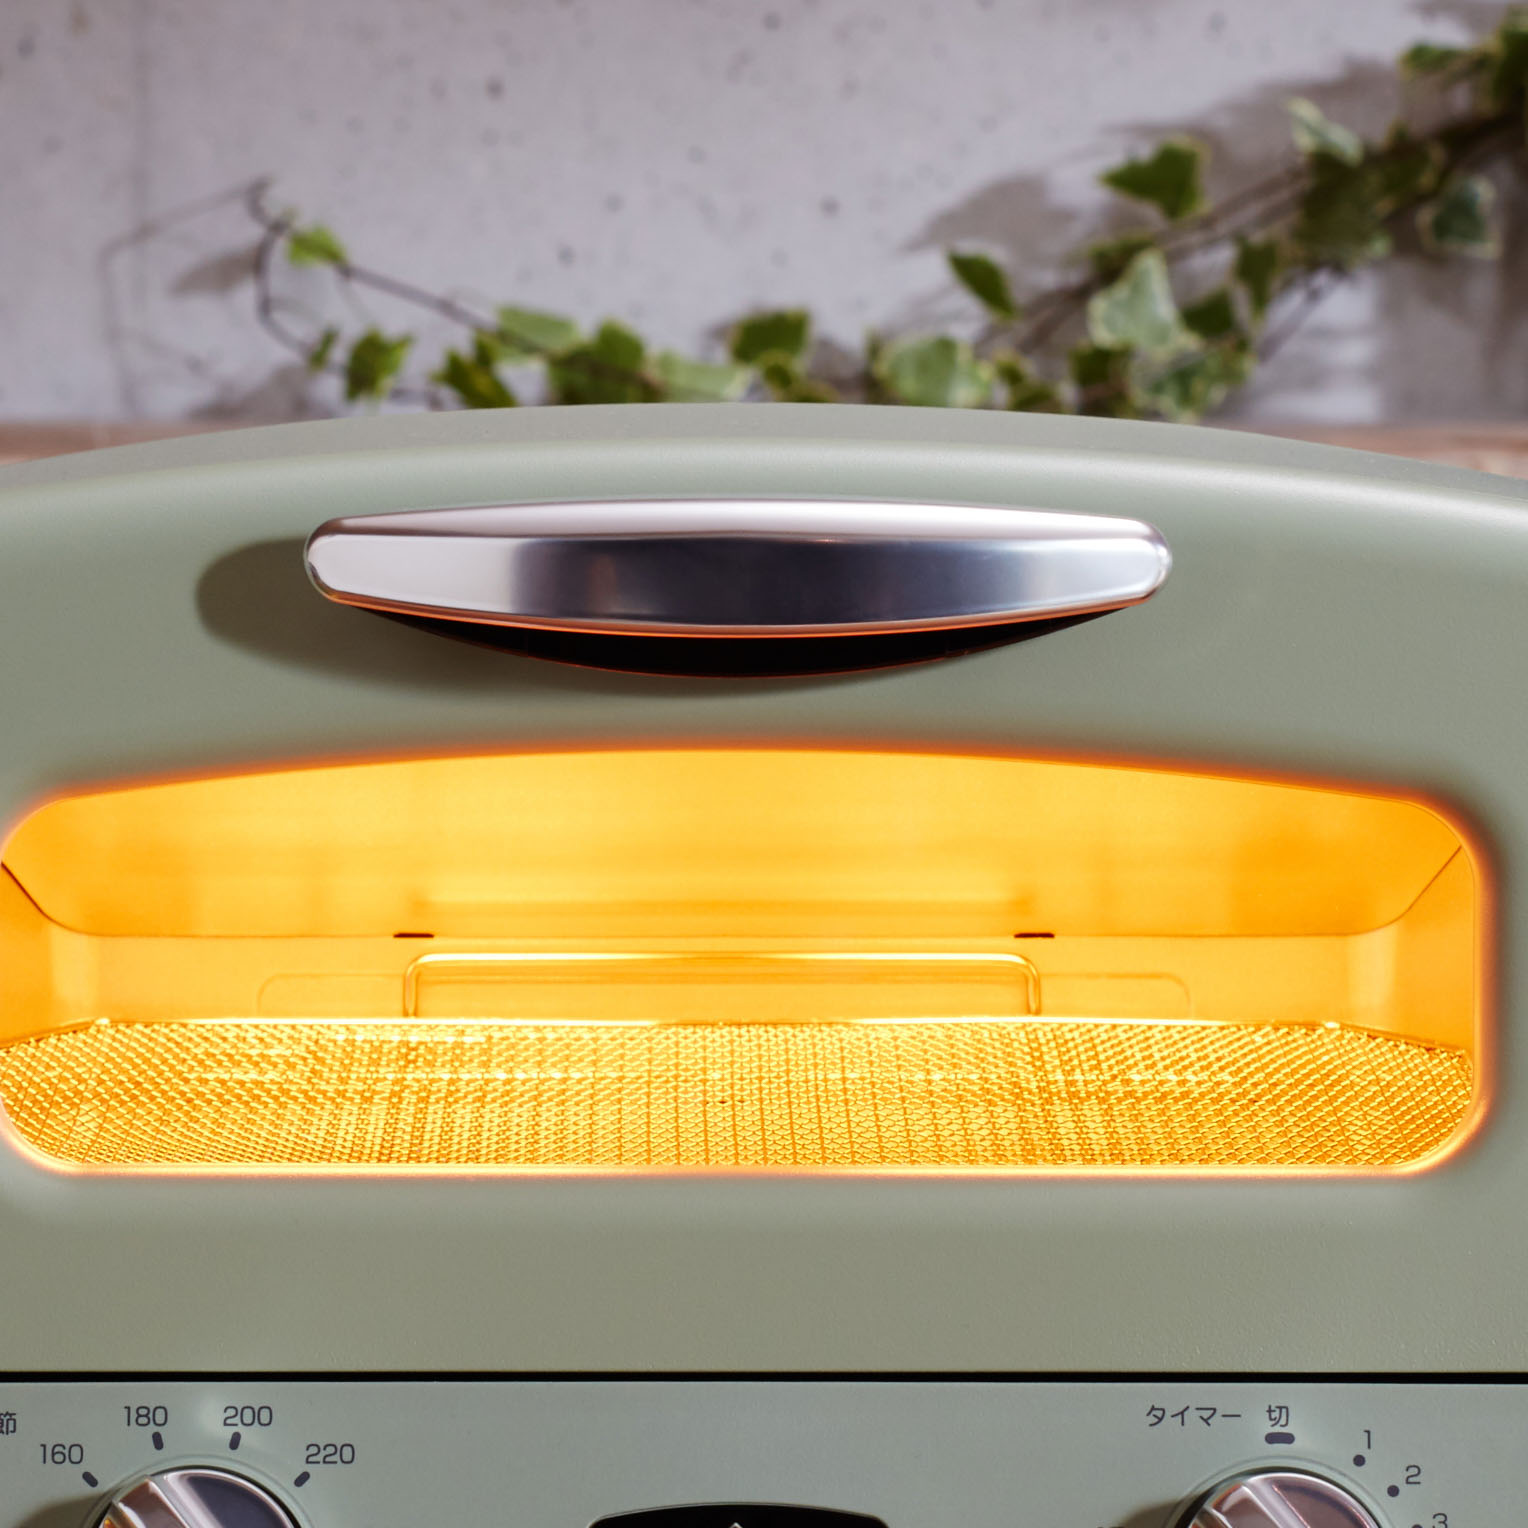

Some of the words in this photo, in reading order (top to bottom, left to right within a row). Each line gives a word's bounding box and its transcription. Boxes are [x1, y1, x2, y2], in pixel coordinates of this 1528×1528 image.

[123, 1405, 169, 1428] 180
[223, 1405, 273, 1427] 200
[1145, 1404, 1242, 1428] タイマー
[1265, 1404, 1290, 1428] 切
[1363, 1429, 1372, 1450] 1
[39, 1443, 84, 1465] 160
[305, 1442, 356, 1465] 220
[1404, 1464, 1422, 1485] 2
